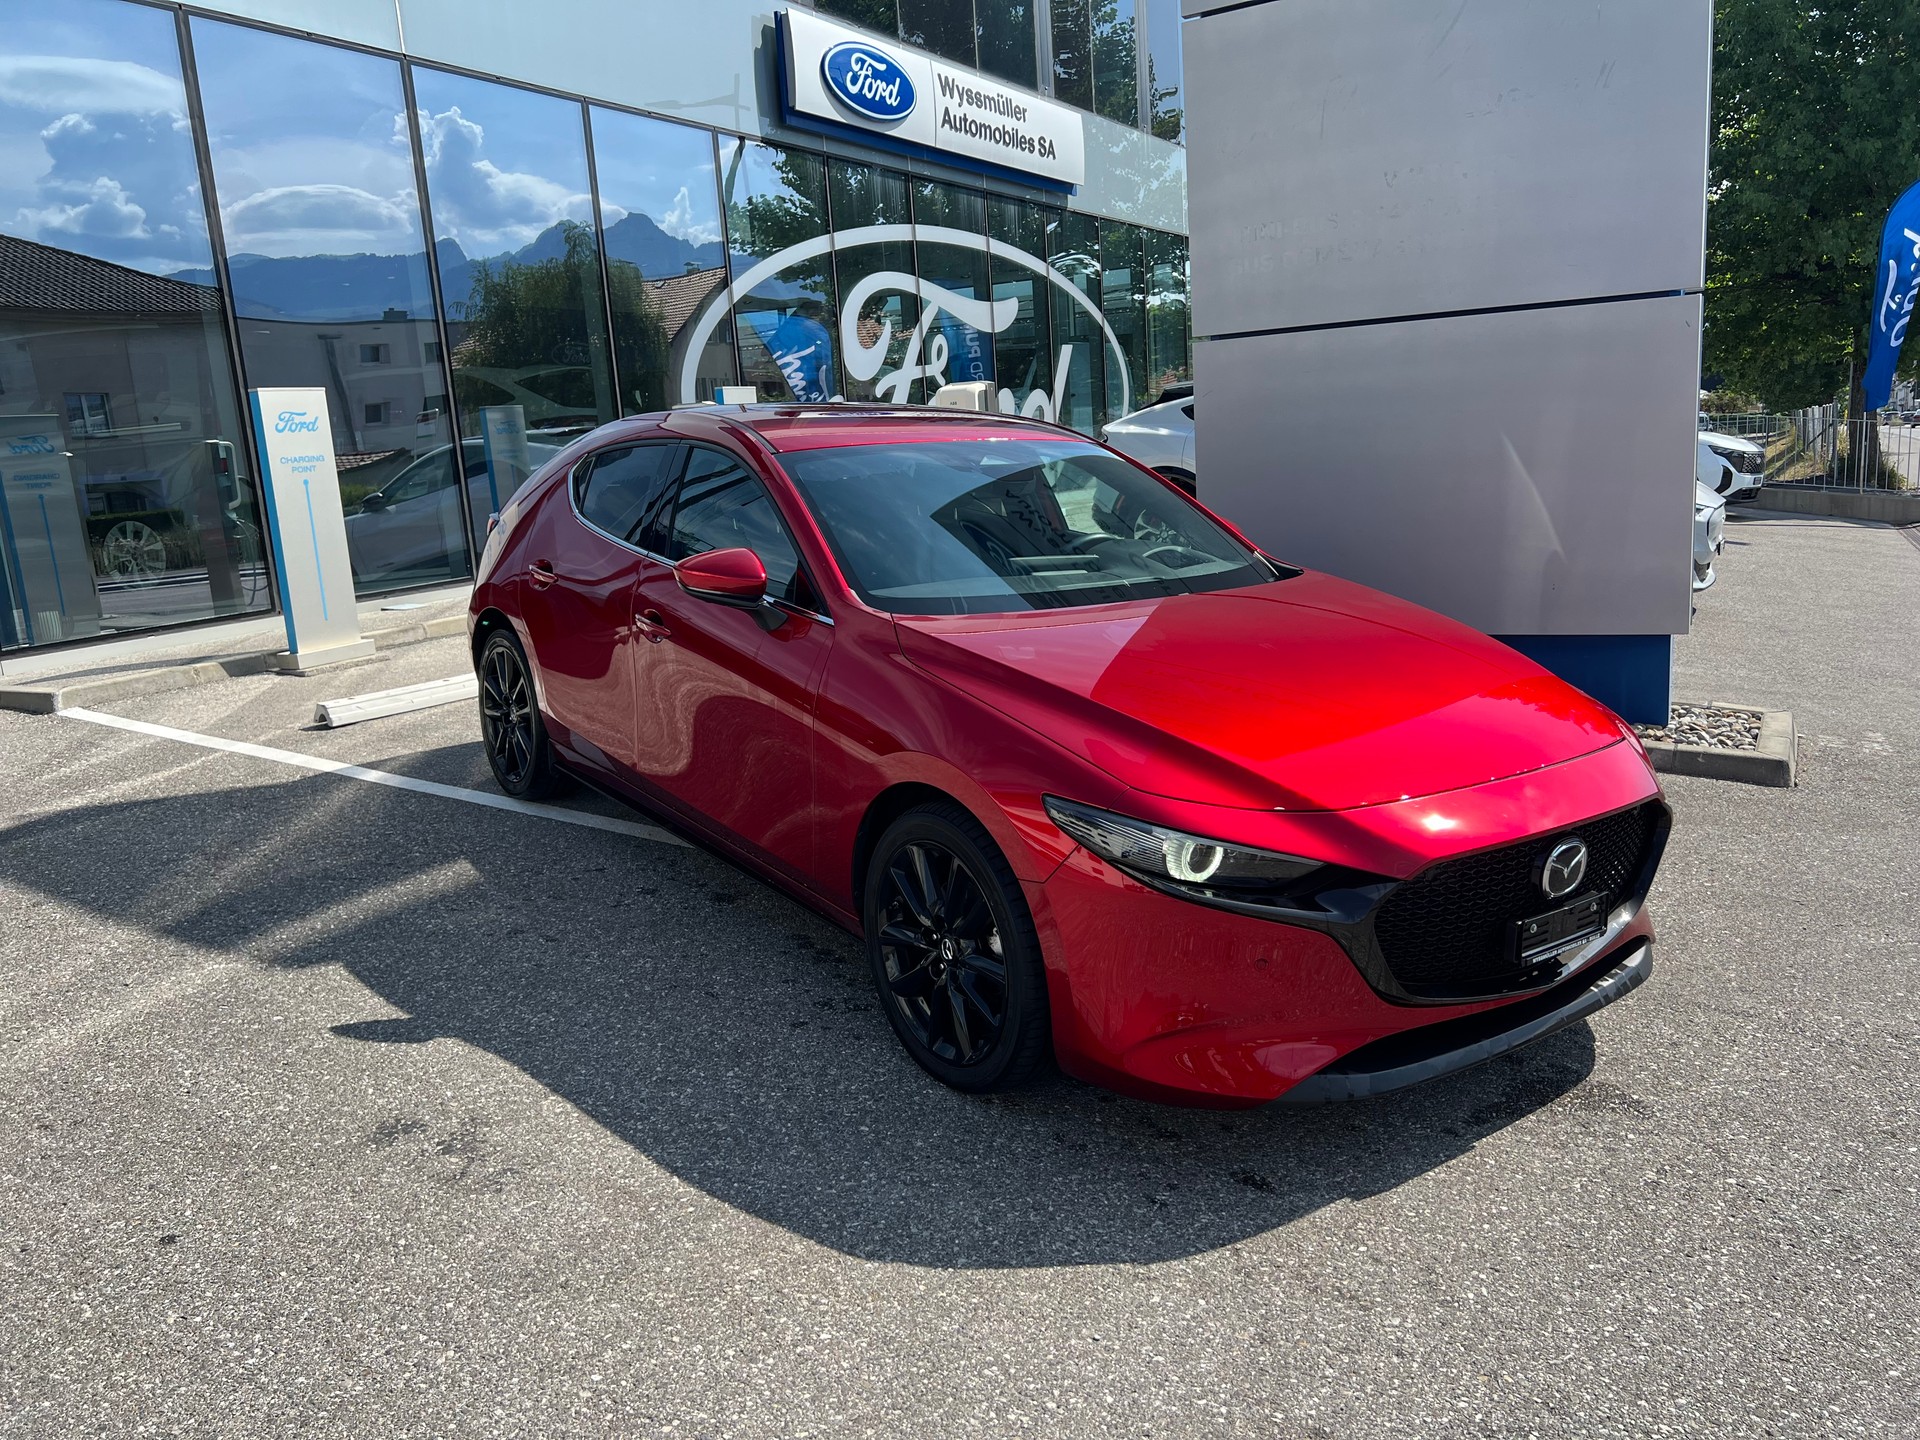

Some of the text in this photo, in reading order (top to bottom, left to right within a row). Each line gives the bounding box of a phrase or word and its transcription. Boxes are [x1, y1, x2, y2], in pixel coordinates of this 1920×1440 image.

[845, 51, 902, 108] Ford
[937, 72, 1028, 124] Wyssmüller
[940, 105, 1057, 161] Automobiles SA
[275, 411, 319, 433] Ford
[280, 454, 326, 465] CHARGING
[291, 465, 317, 474] POINT
